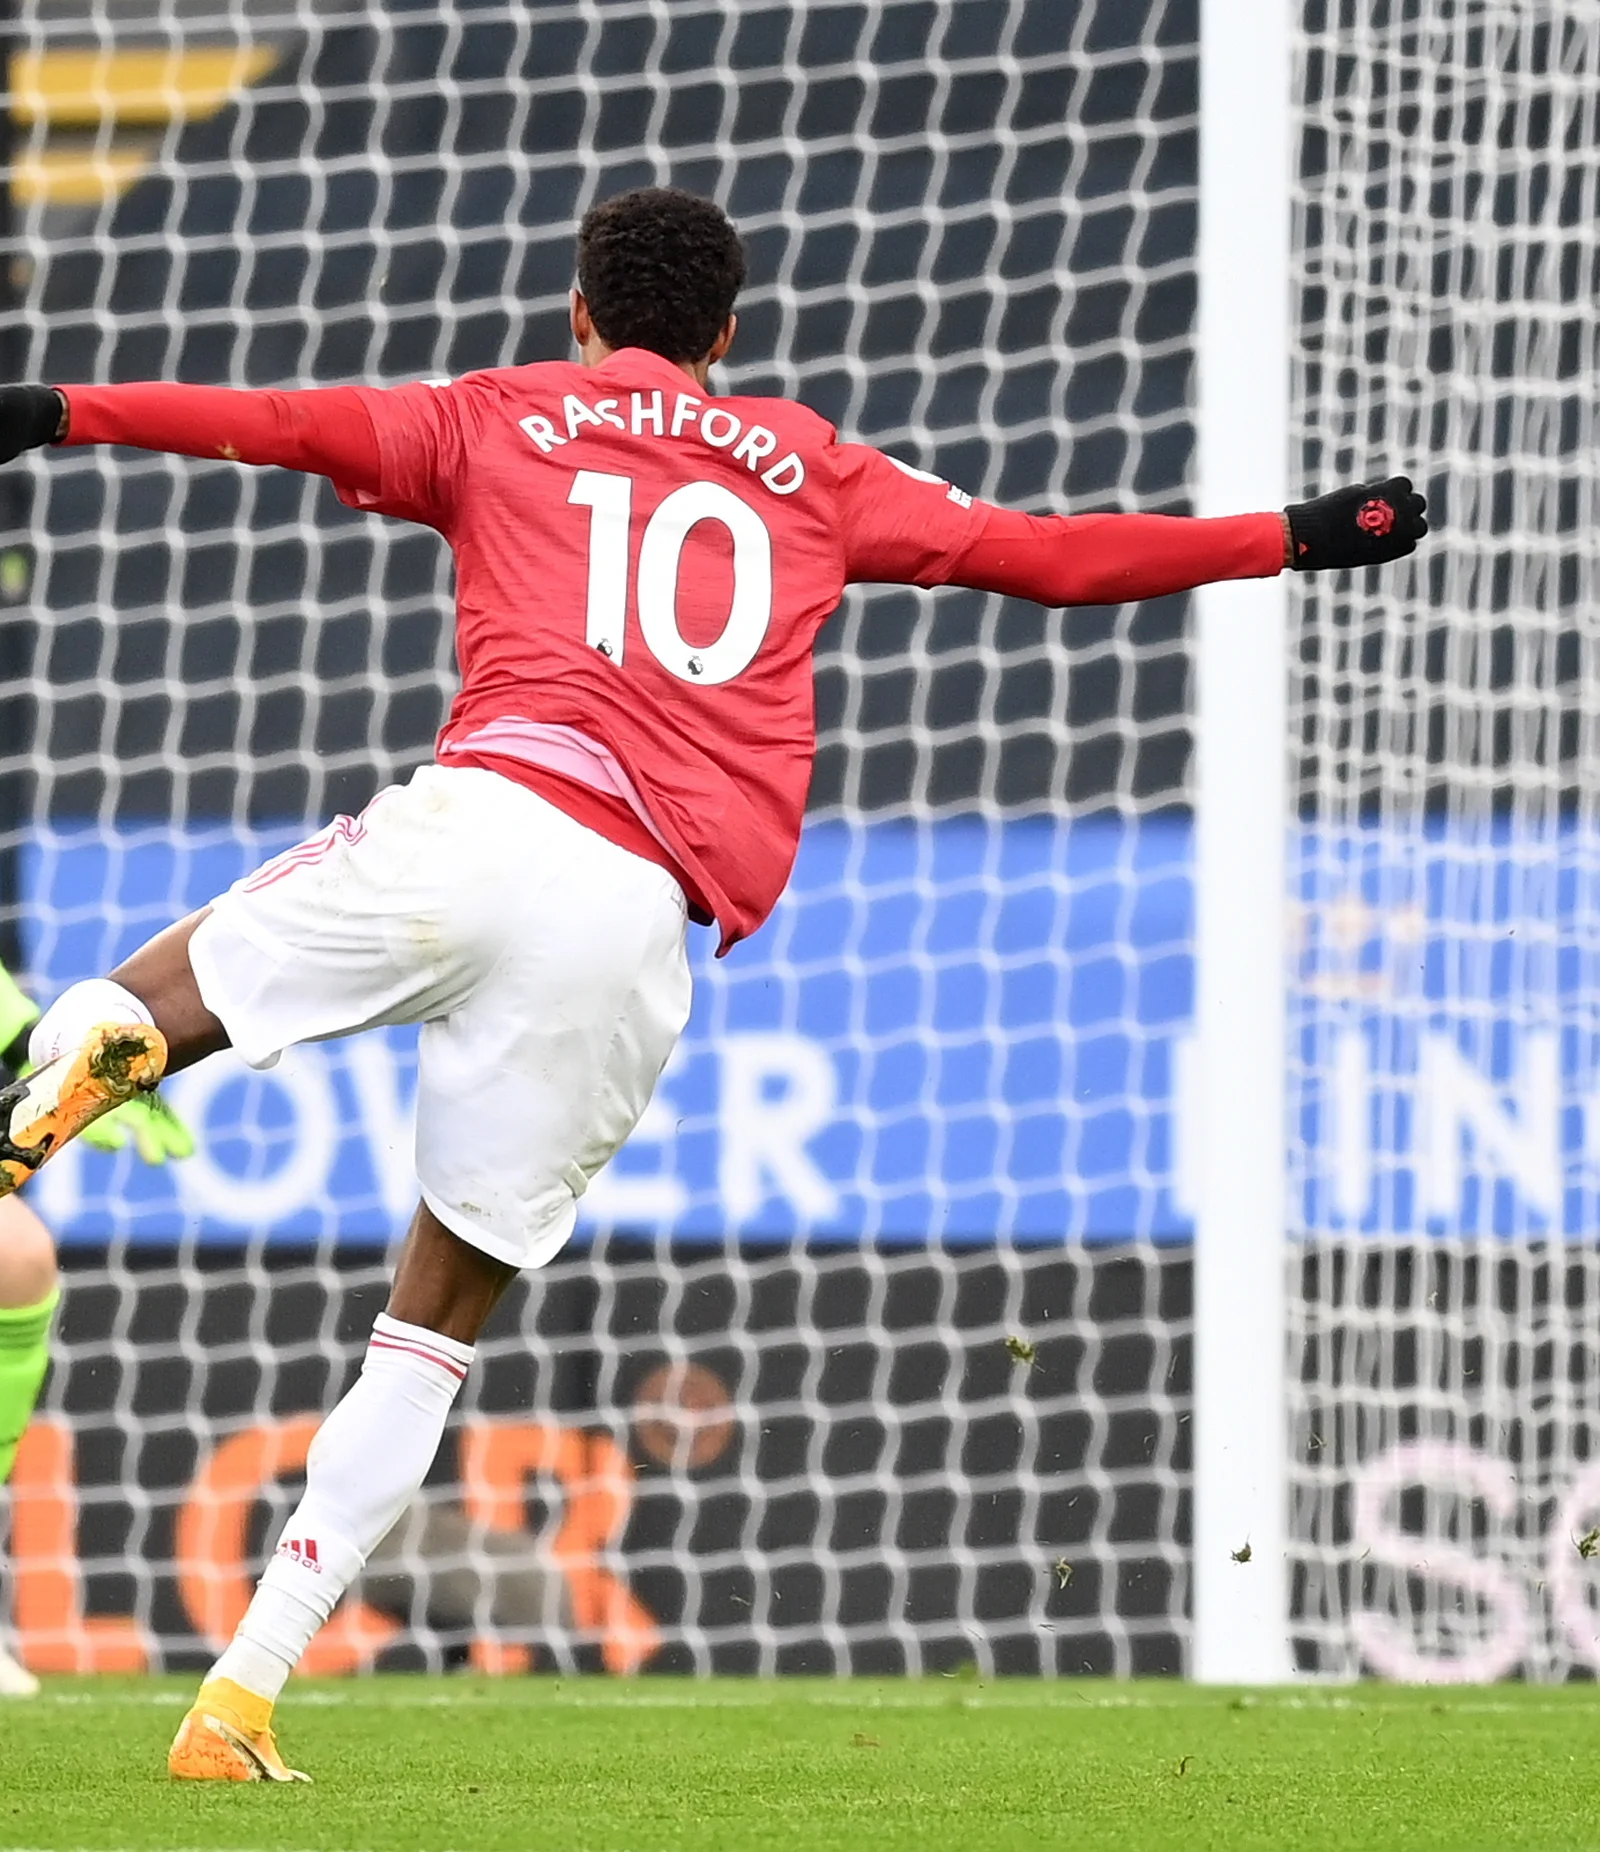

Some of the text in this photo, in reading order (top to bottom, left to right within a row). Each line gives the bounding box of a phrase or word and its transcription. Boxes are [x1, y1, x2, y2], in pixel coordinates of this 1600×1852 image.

[518, 390, 805, 496] RASHFORD
[566, 468, 773, 686] 10
[32, 1030, 840, 1224] OER
